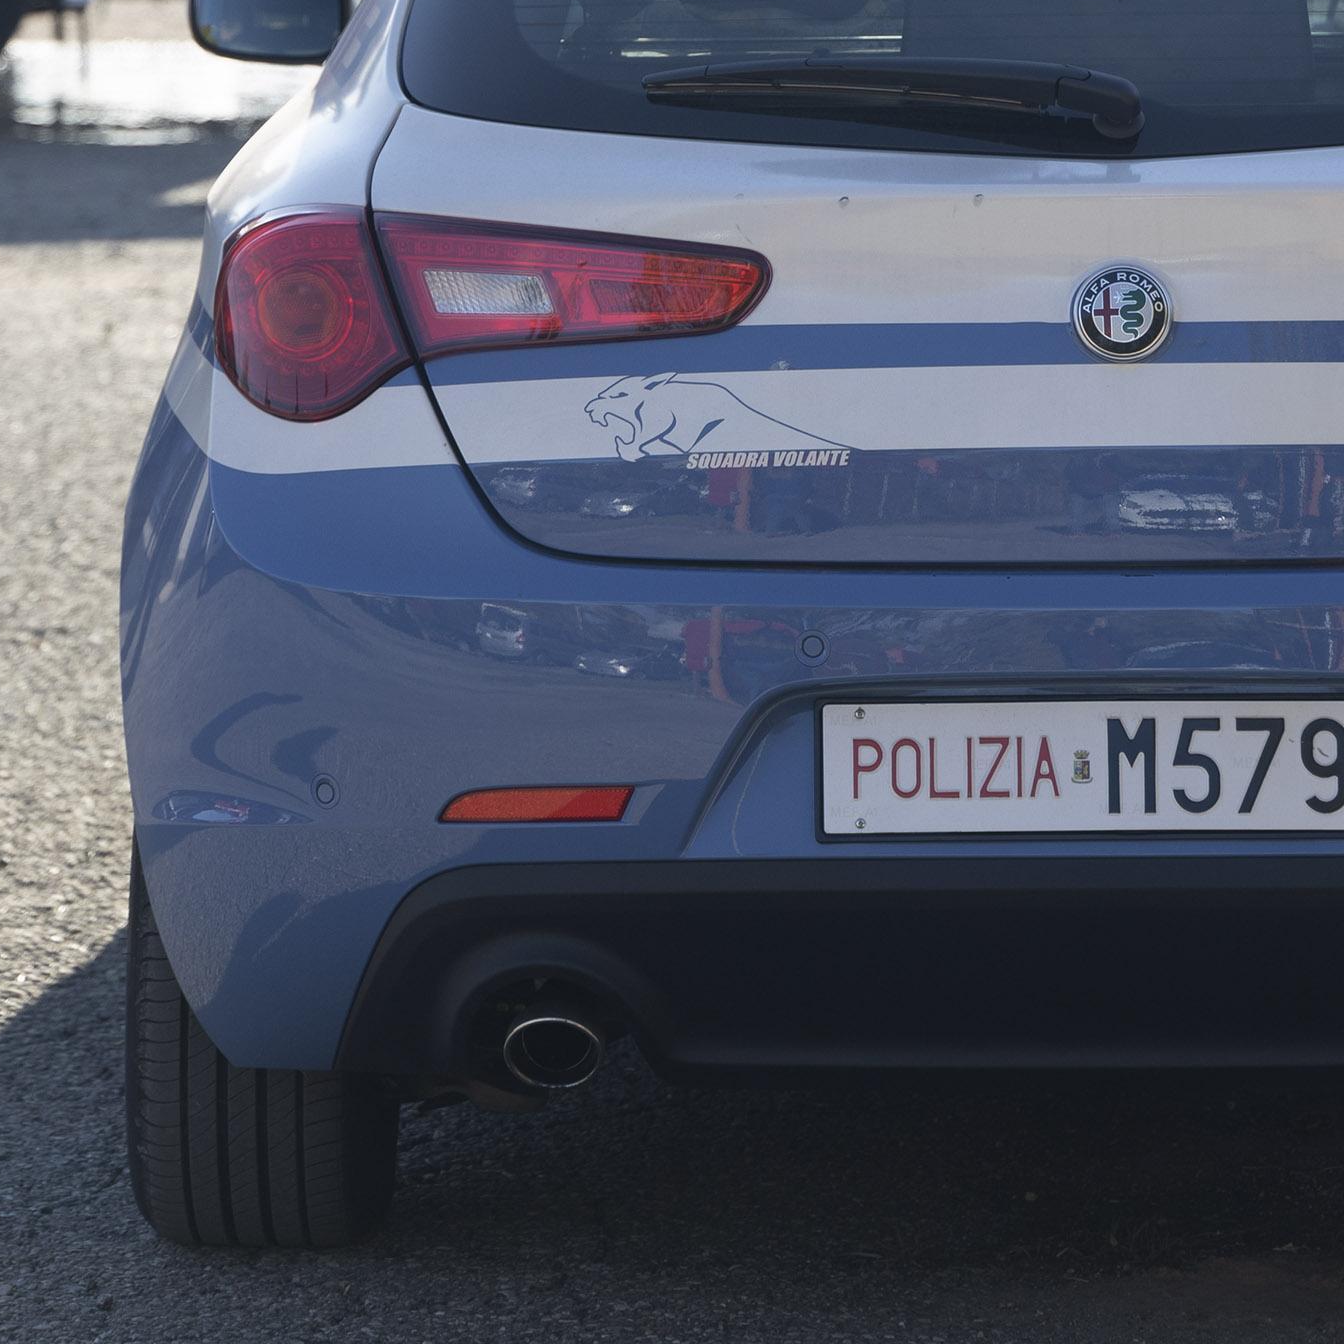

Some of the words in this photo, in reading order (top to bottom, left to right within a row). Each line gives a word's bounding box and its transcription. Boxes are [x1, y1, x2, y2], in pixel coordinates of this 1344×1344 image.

[1083, 278, 1110, 314] ALFA
[1116, 272, 1164, 313] ROMEO
[686, 451, 769, 470] SQUADRA
[772, 448, 852, 468] VOLANTE
[852, 736, 1061, 800] POLIZIA
